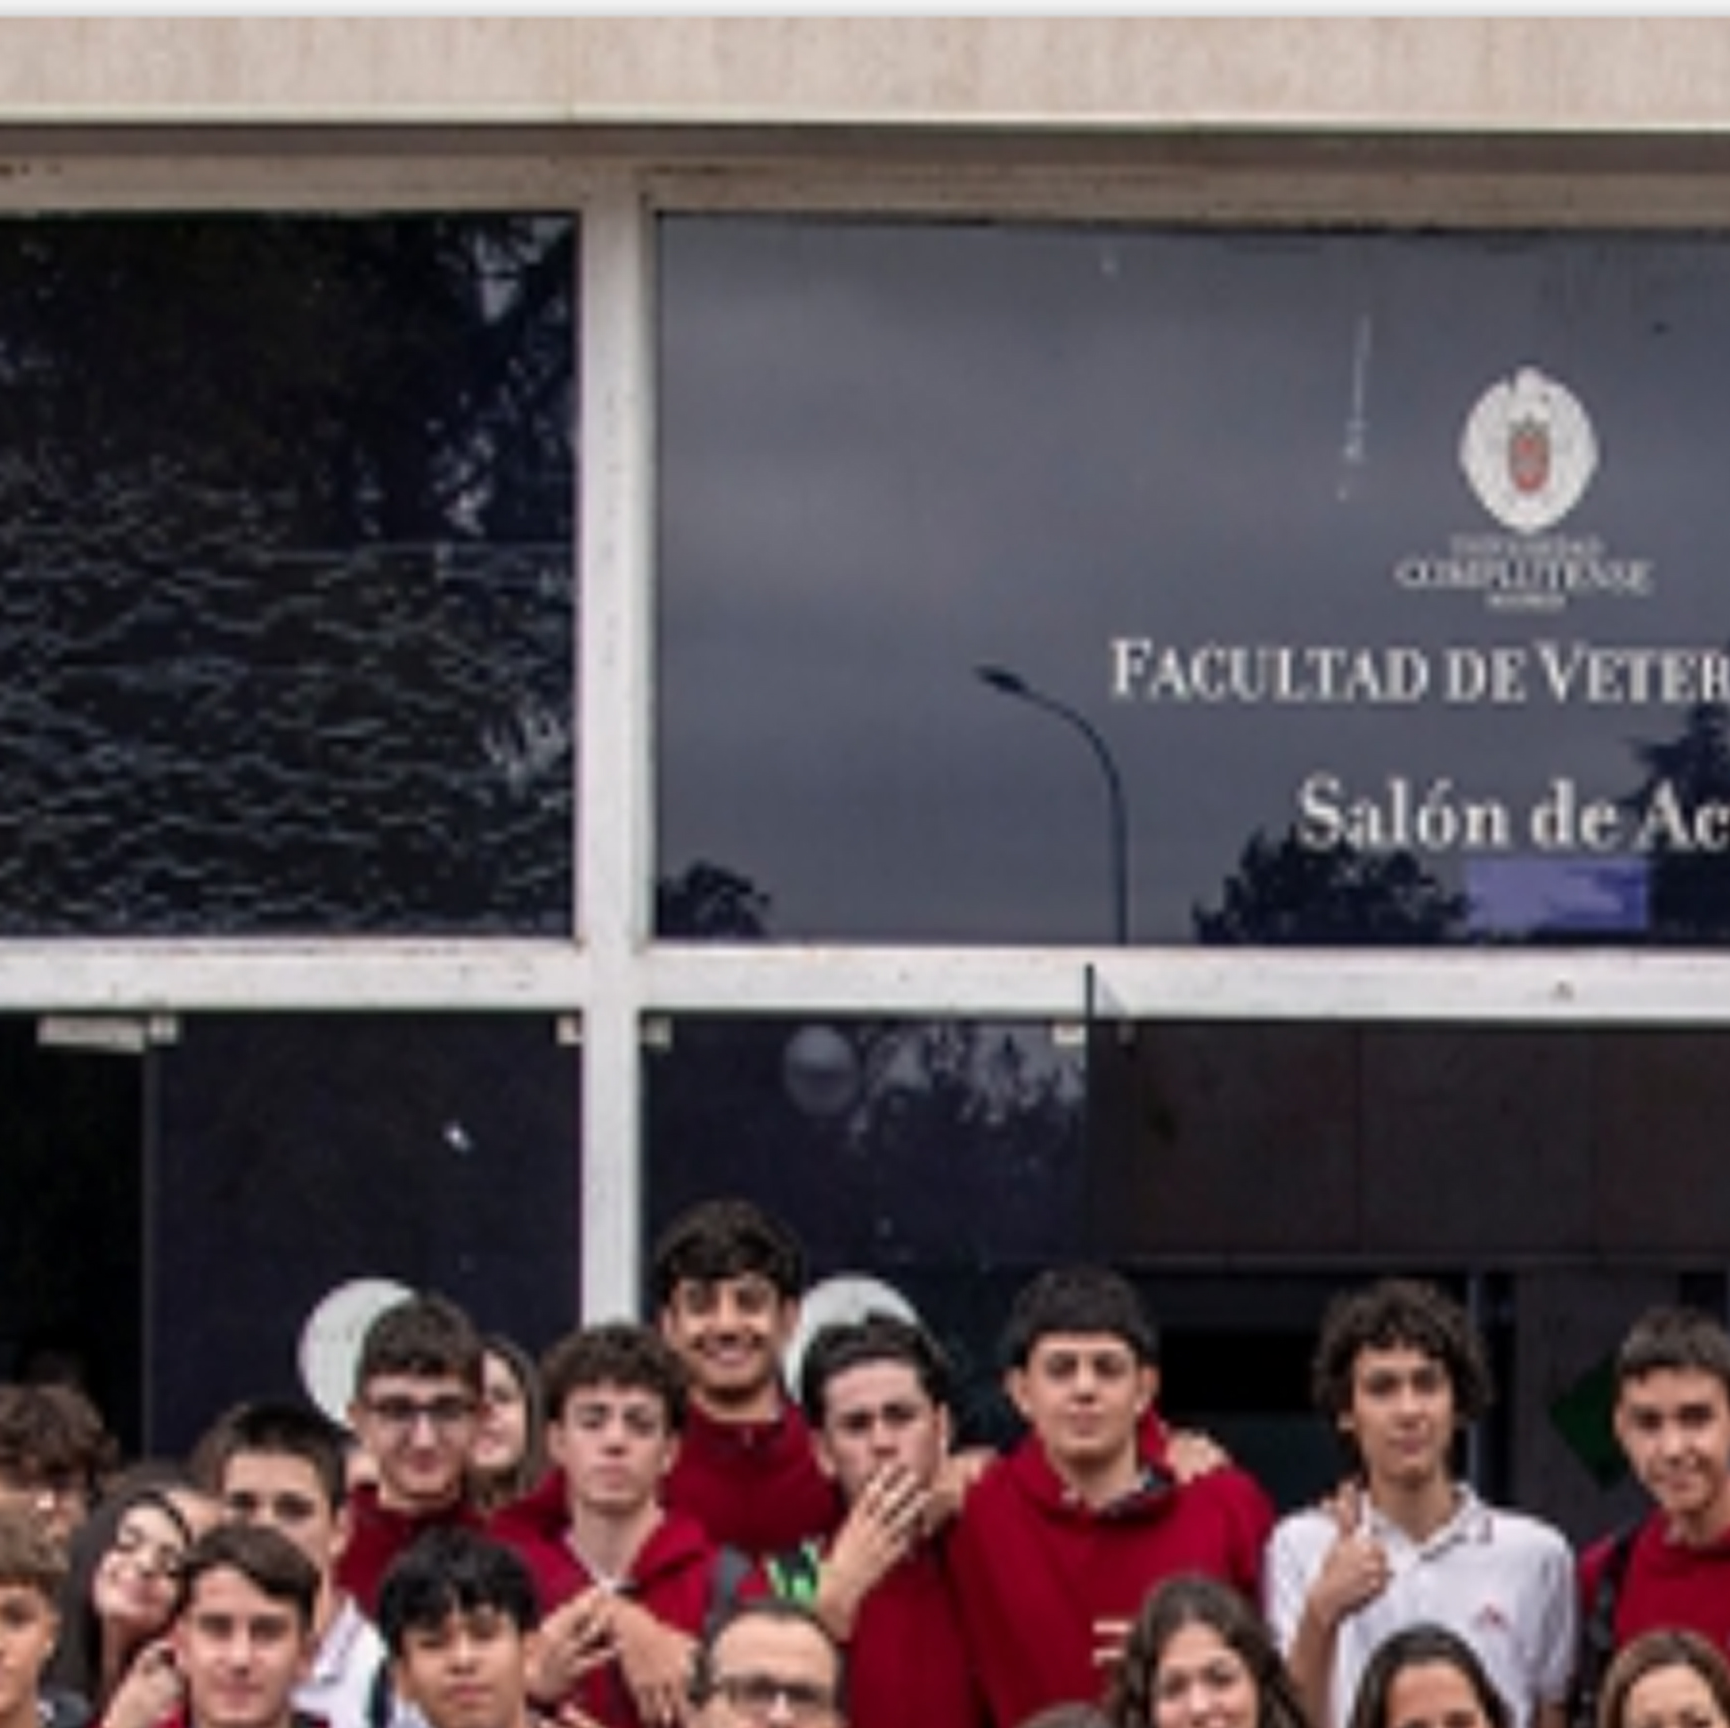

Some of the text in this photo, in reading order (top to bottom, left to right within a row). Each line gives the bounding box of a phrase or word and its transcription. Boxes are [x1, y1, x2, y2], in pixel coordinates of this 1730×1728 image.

[1110, 637, 1431, 702] FACULTAD
[1443, 647, 1527, 702] DE
[1298, 776, 1510, 850] Salón
[1530, 777, 1620, 850] de
